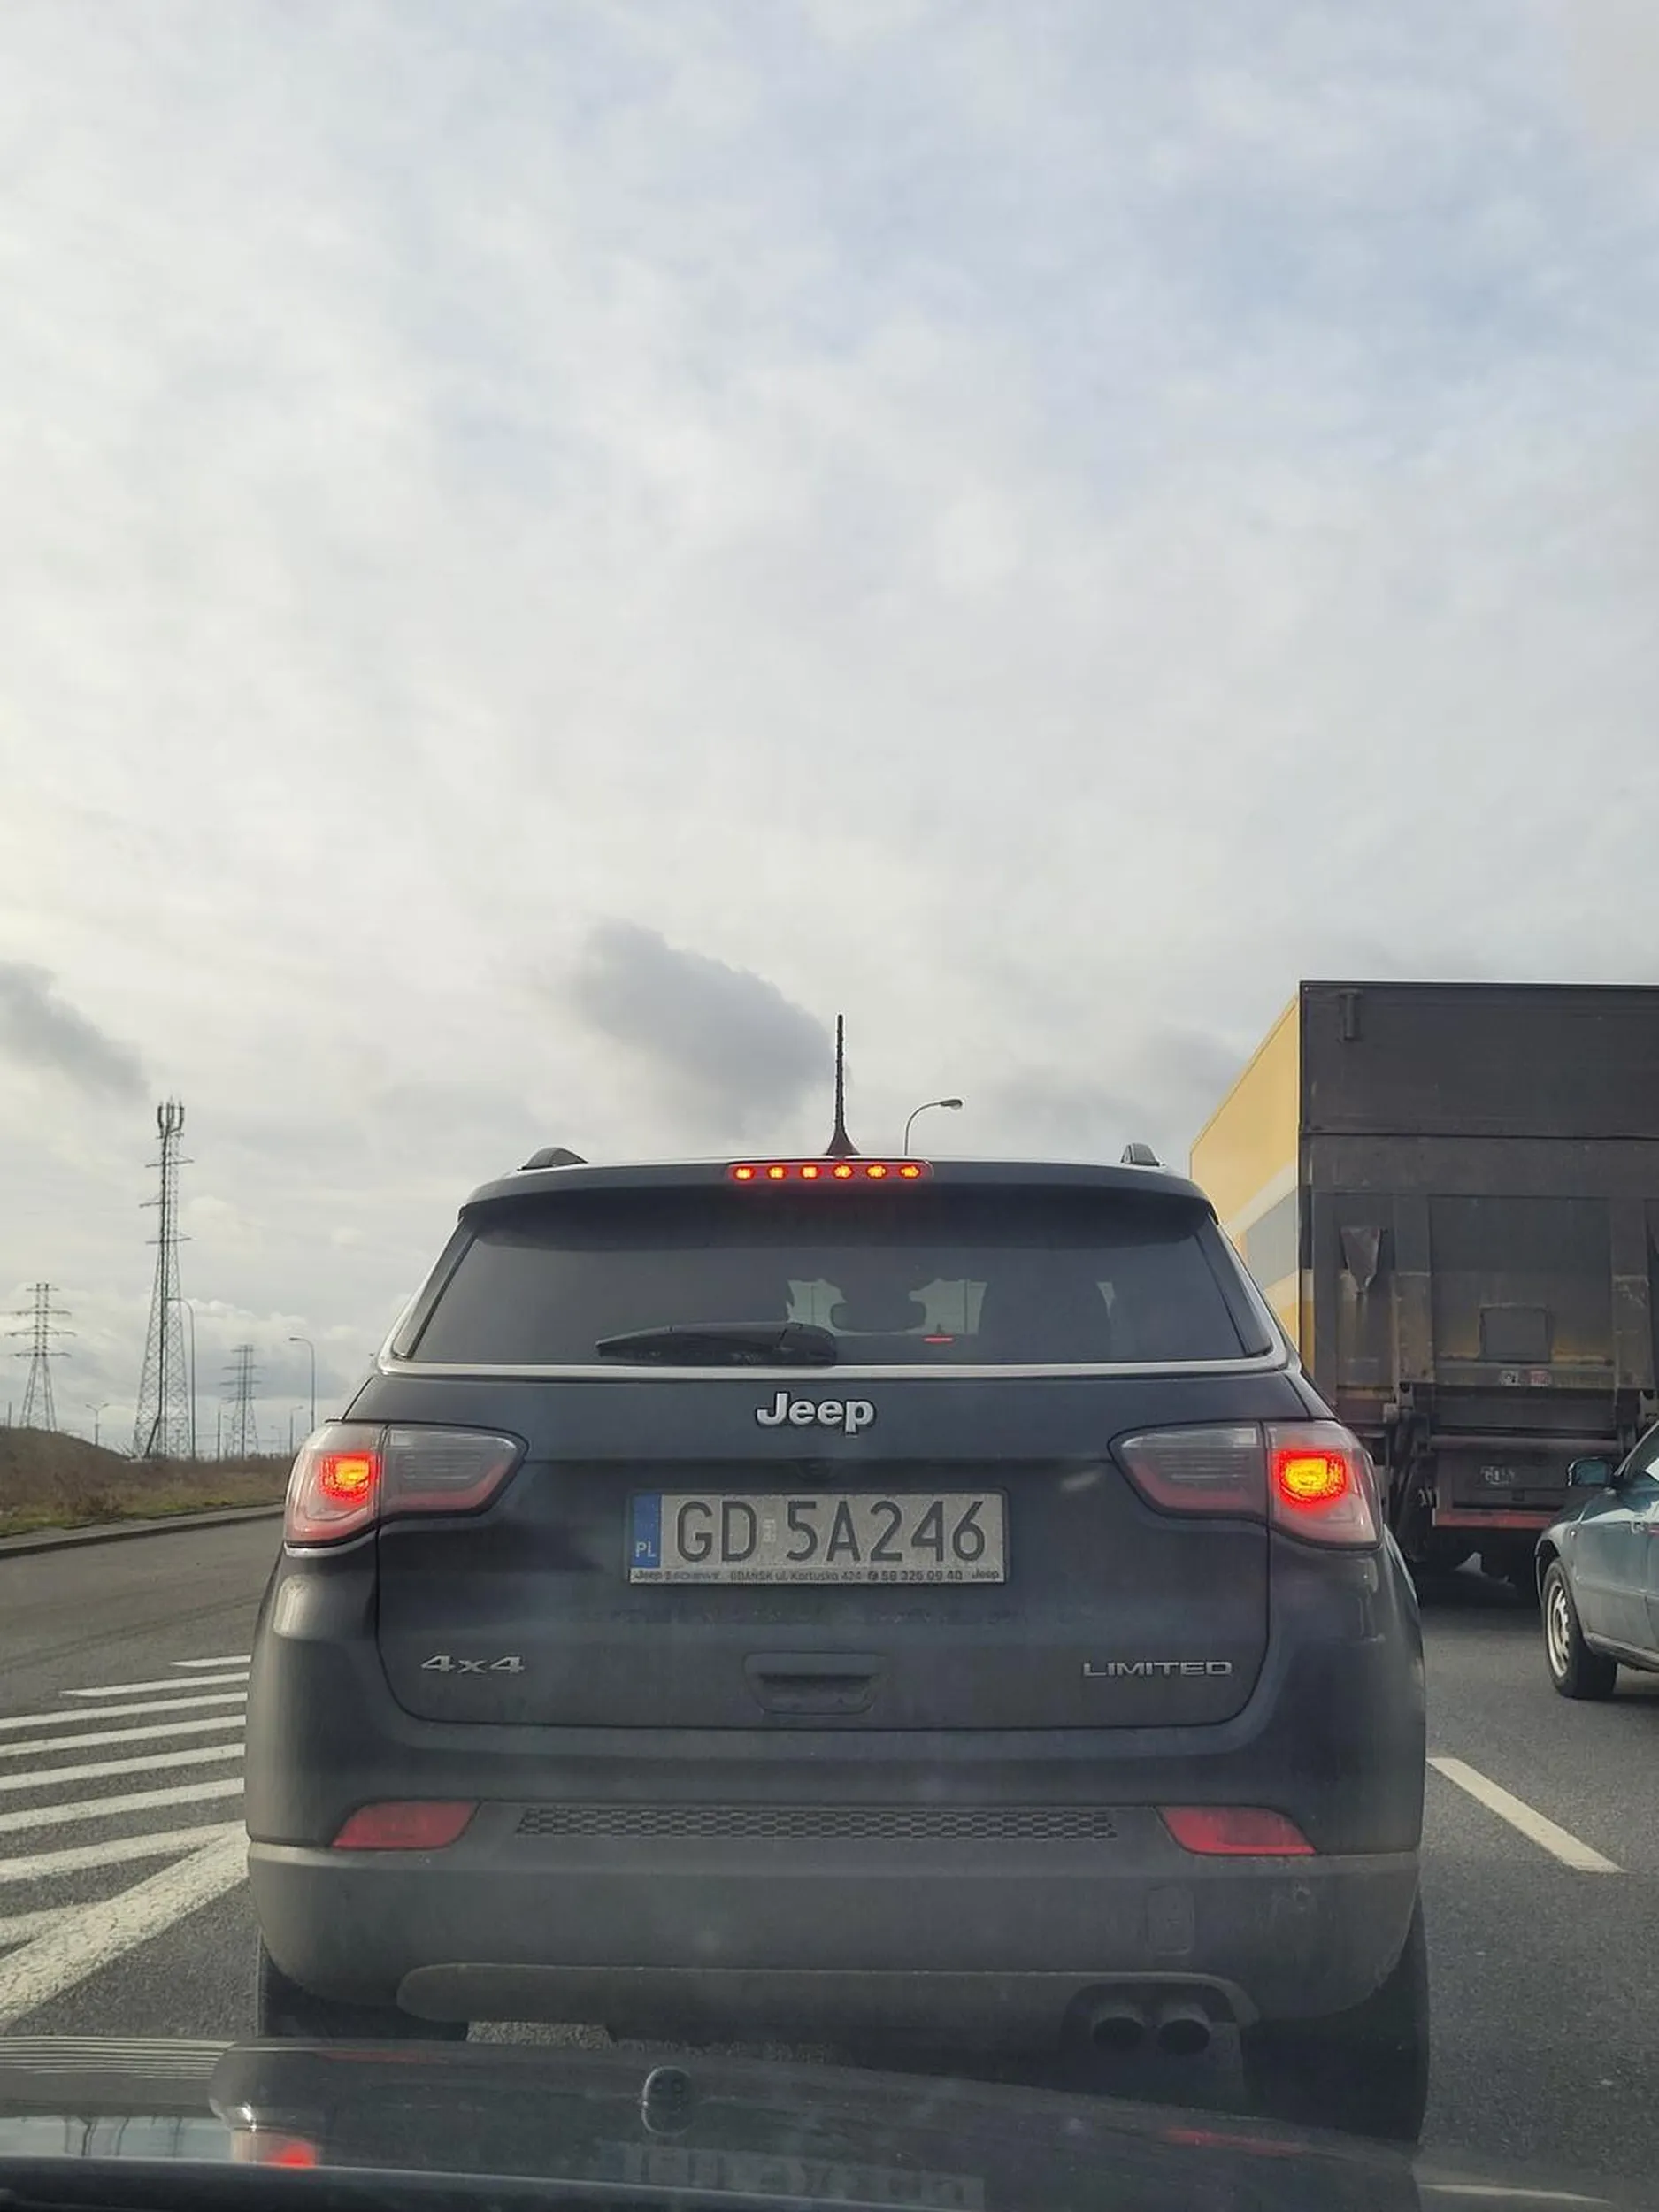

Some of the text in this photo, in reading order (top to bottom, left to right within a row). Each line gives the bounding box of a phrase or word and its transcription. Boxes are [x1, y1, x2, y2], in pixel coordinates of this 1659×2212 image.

[757, 1392, 874, 1433] Jeep
[676, 1500, 986, 1563] GD 5A246
[635, 1540, 657, 1557] PL
[420, 1655, 525, 1673] 4x4
[1083, 1661, 1233, 1677] LIMITED
